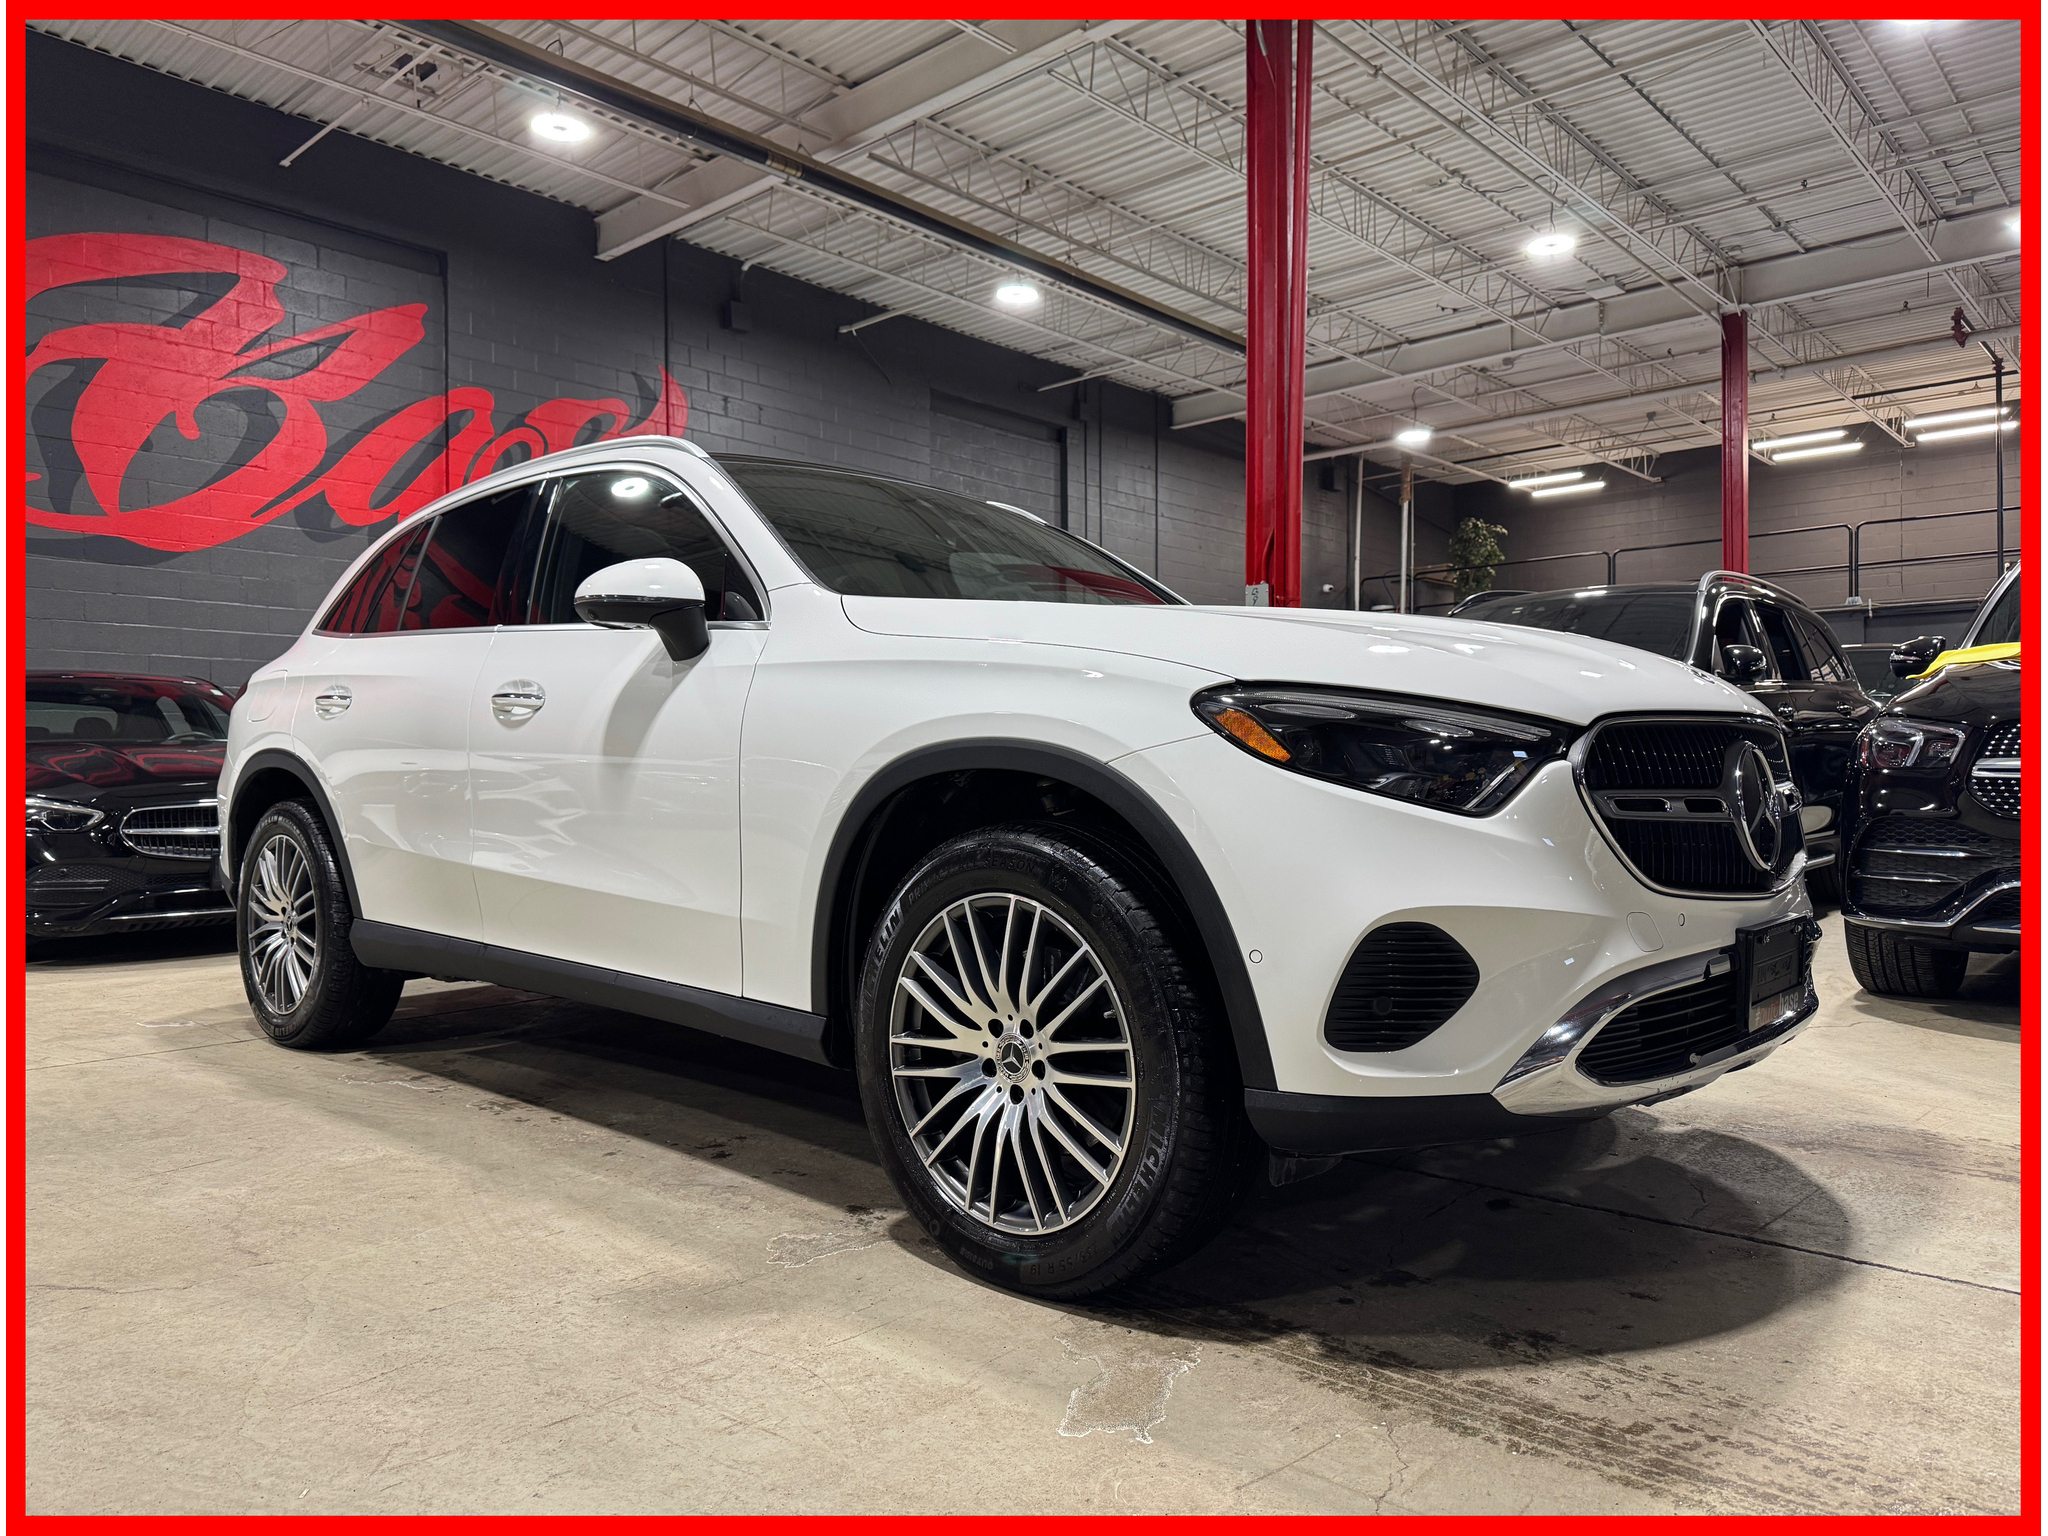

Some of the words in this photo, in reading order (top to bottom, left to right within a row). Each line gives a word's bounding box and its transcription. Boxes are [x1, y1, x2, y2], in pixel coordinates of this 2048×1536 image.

[984, 855, 1036, 875] SEASON
[1108, 1106, 1167, 1249] MICHELIN
[1029, 1263, 1041, 1276] 19
[1046, 1261, 1056, 1276] R
